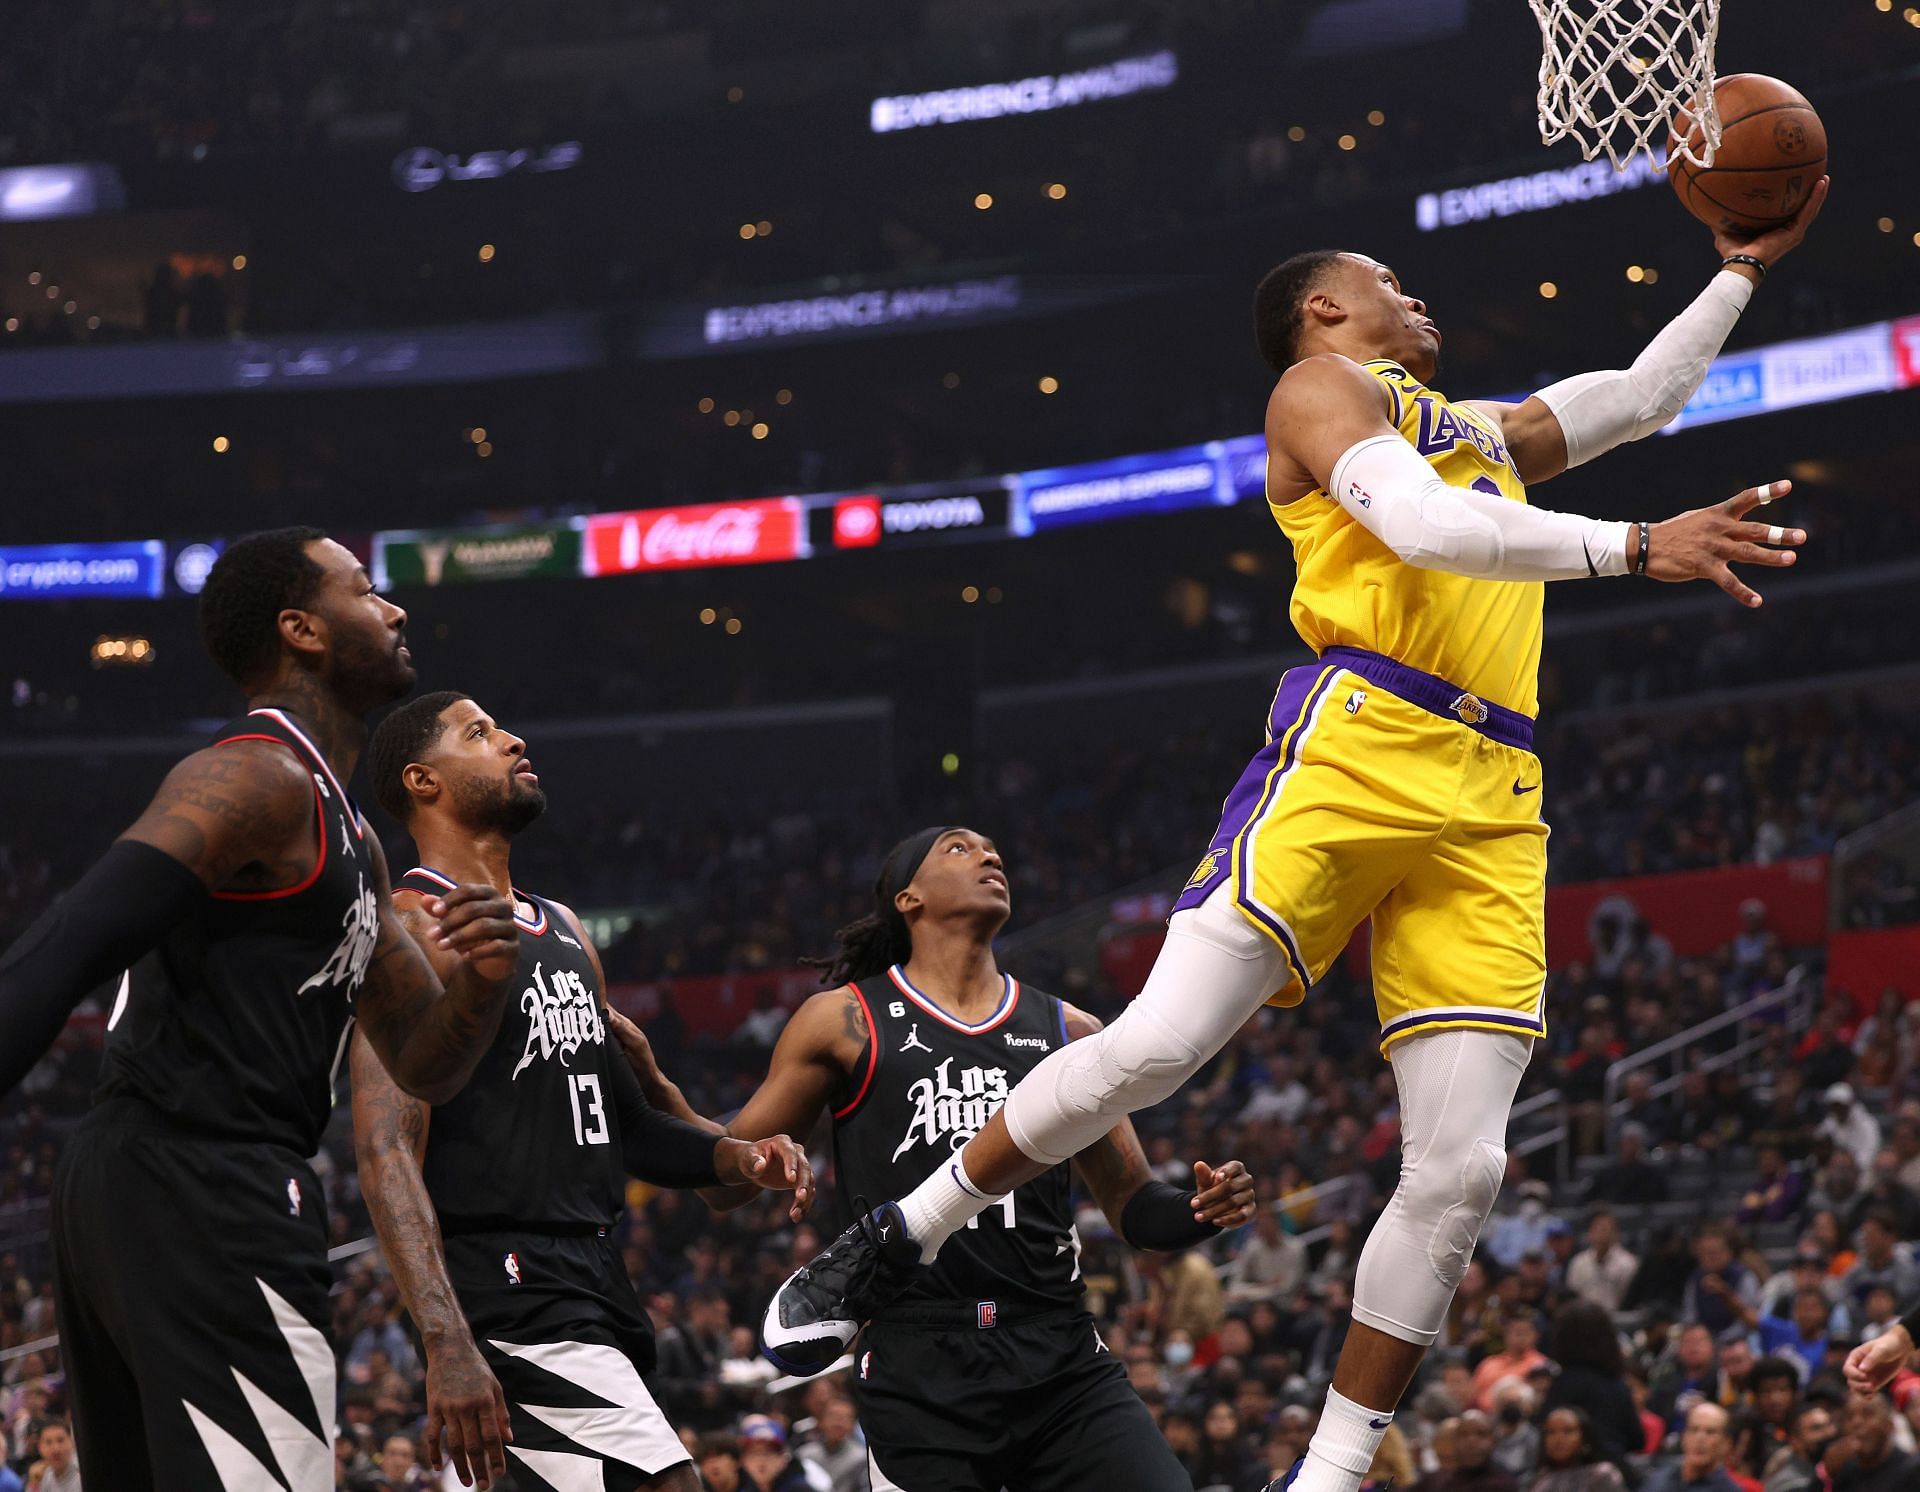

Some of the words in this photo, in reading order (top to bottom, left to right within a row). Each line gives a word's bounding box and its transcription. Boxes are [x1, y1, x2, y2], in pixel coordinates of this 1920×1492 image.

[882, 496, 984, 533] TOYOTA
[7, 558, 139, 590] crypto.com
[314, 773, 330, 798] 6
[532, 961, 589, 1009] Los
[888, 1001, 906, 1018] 6
[1004, 1032, 1050, 1052] honey
[935, 1056, 1009, 1100] Los
[567, 1073, 610, 1146] 13
